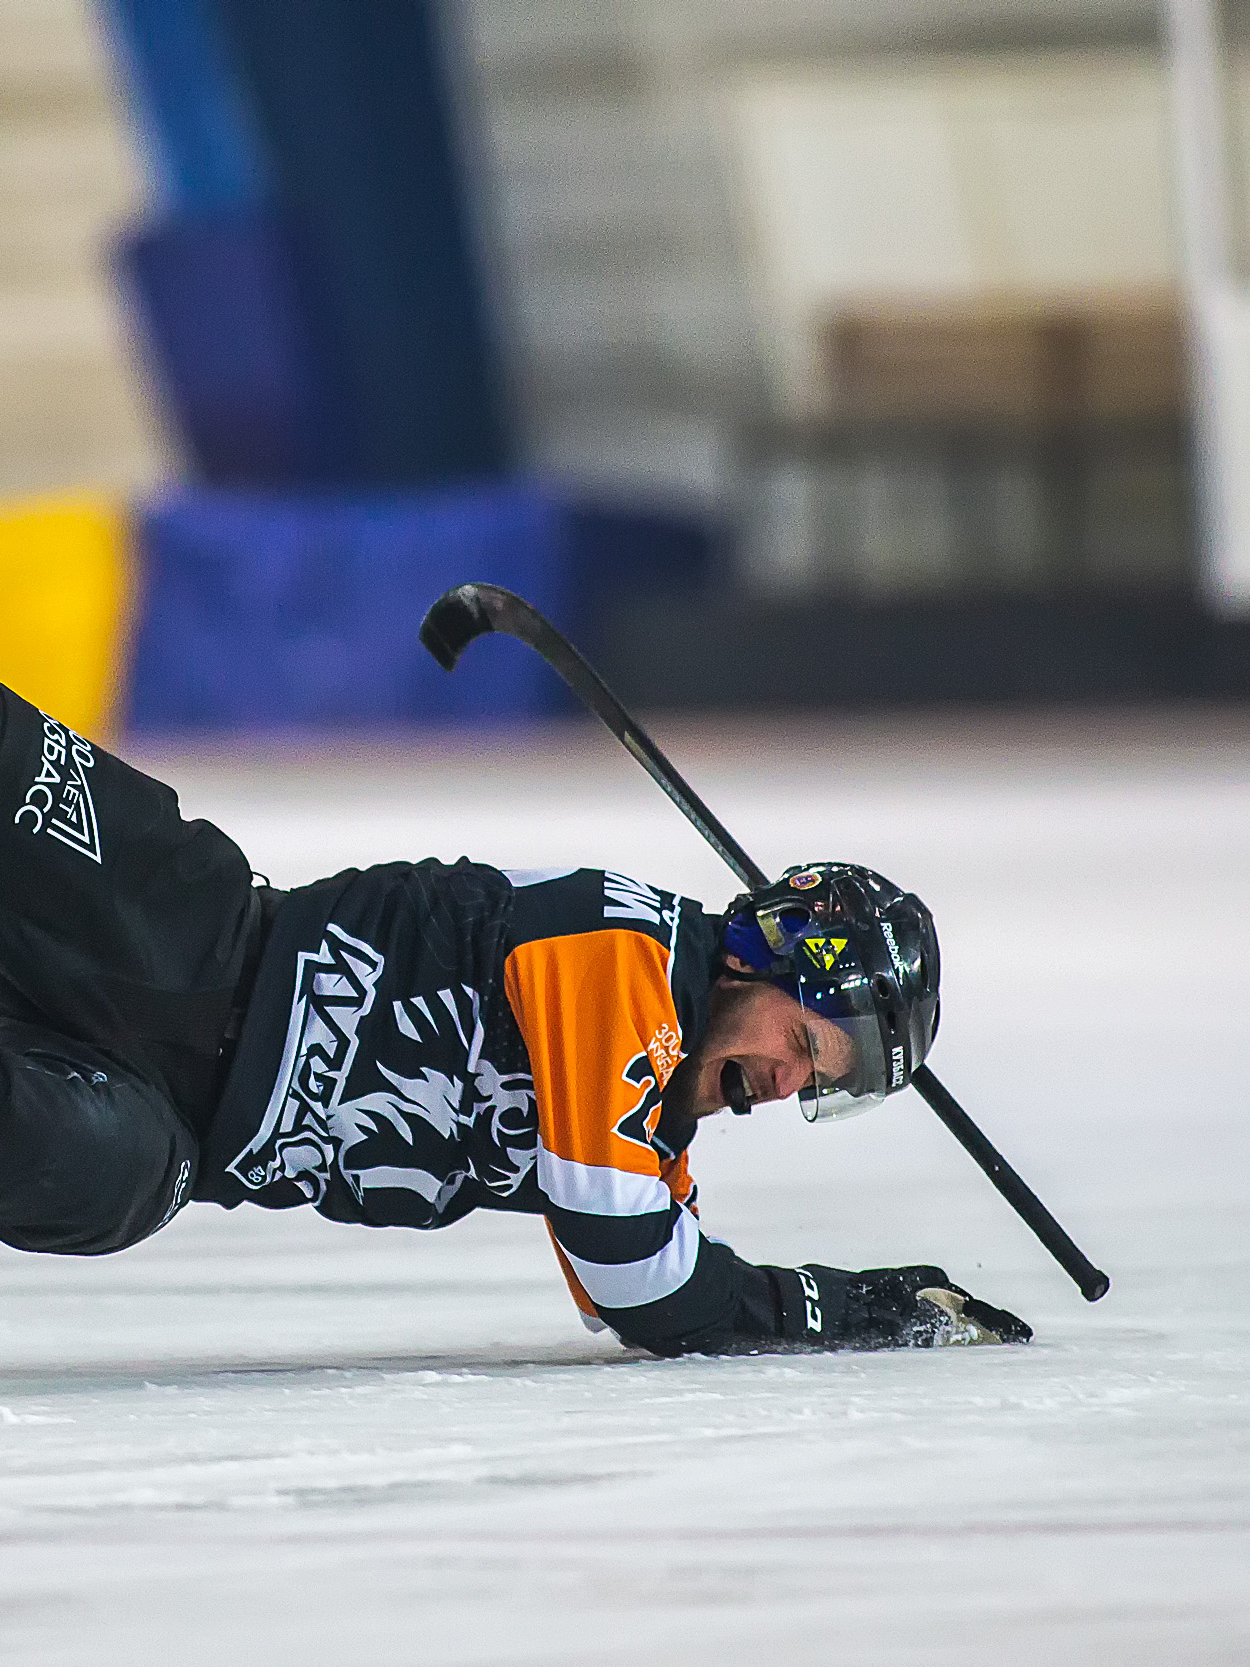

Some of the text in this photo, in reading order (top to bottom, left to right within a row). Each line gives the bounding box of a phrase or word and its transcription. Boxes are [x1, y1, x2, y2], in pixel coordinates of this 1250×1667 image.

[879, 921, 906, 973] Reebok
[891, 1045, 905, 1088] КУЗБАСС
[794, 1268, 822, 1333] CC
